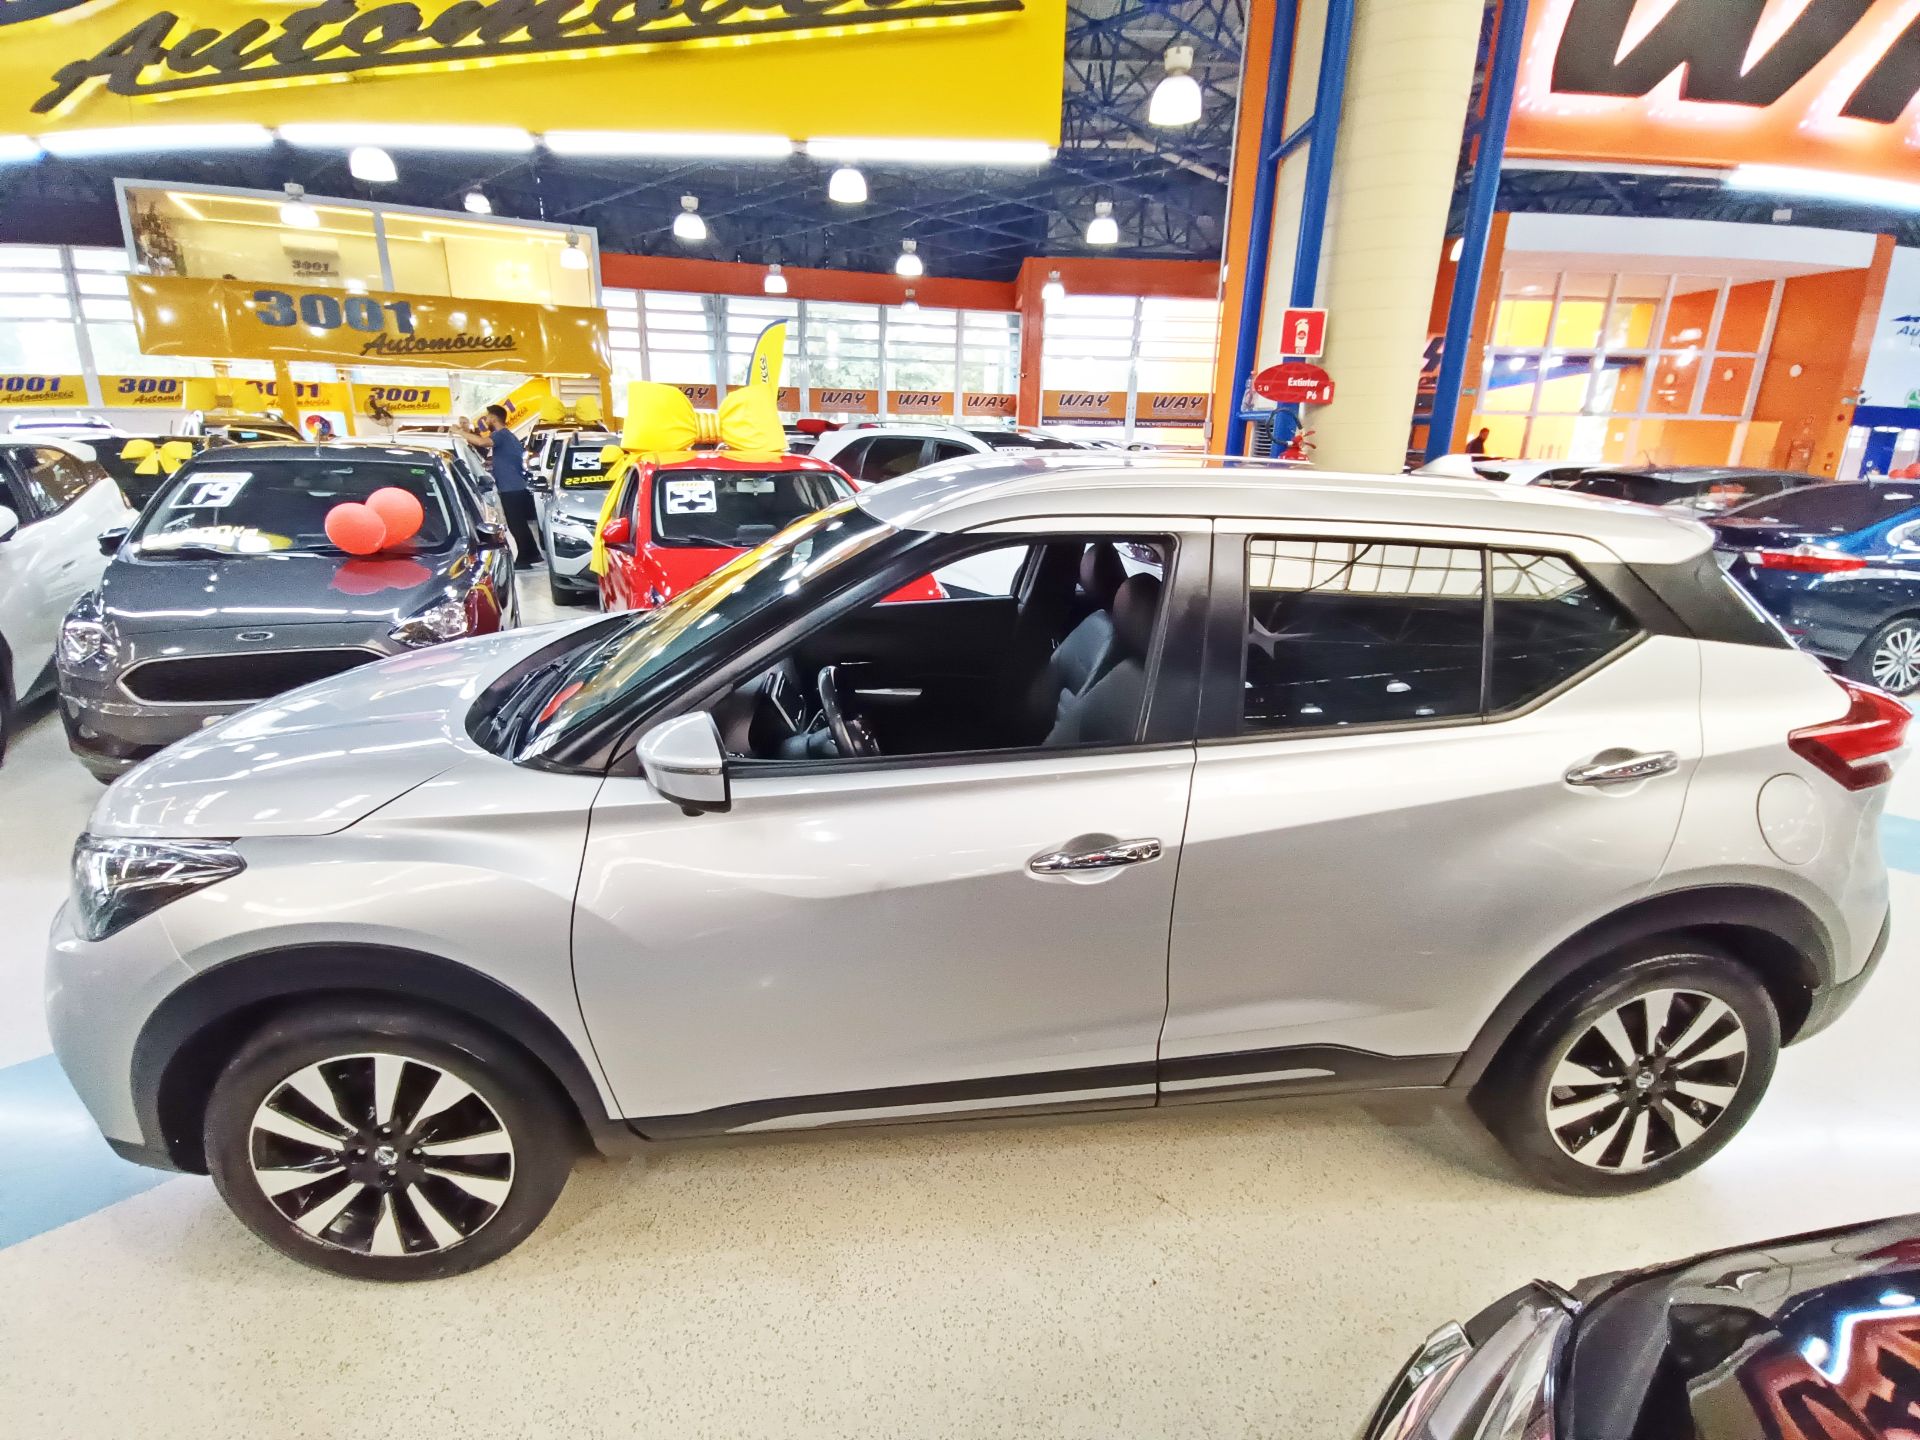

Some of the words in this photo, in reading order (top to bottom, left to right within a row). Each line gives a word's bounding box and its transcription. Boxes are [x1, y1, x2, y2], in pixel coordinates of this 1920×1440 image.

[253, 290, 415, 334] 3001
[360, 333, 516, 356] Automóveis
[0, 376, 60, 392] 001
[118, 378, 183, 393] 300
[1288, 377, 1320, 388] Extintor
[821, 391, 866, 404] WAY
[898, 394, 942, 406] WAY
[967, 396, 1009, 408] WAY
[1059, 393, 1109, 407] WAY
[1306, 390, 1317, 401] P6
[1153, 396, 1203, 409] WAY
